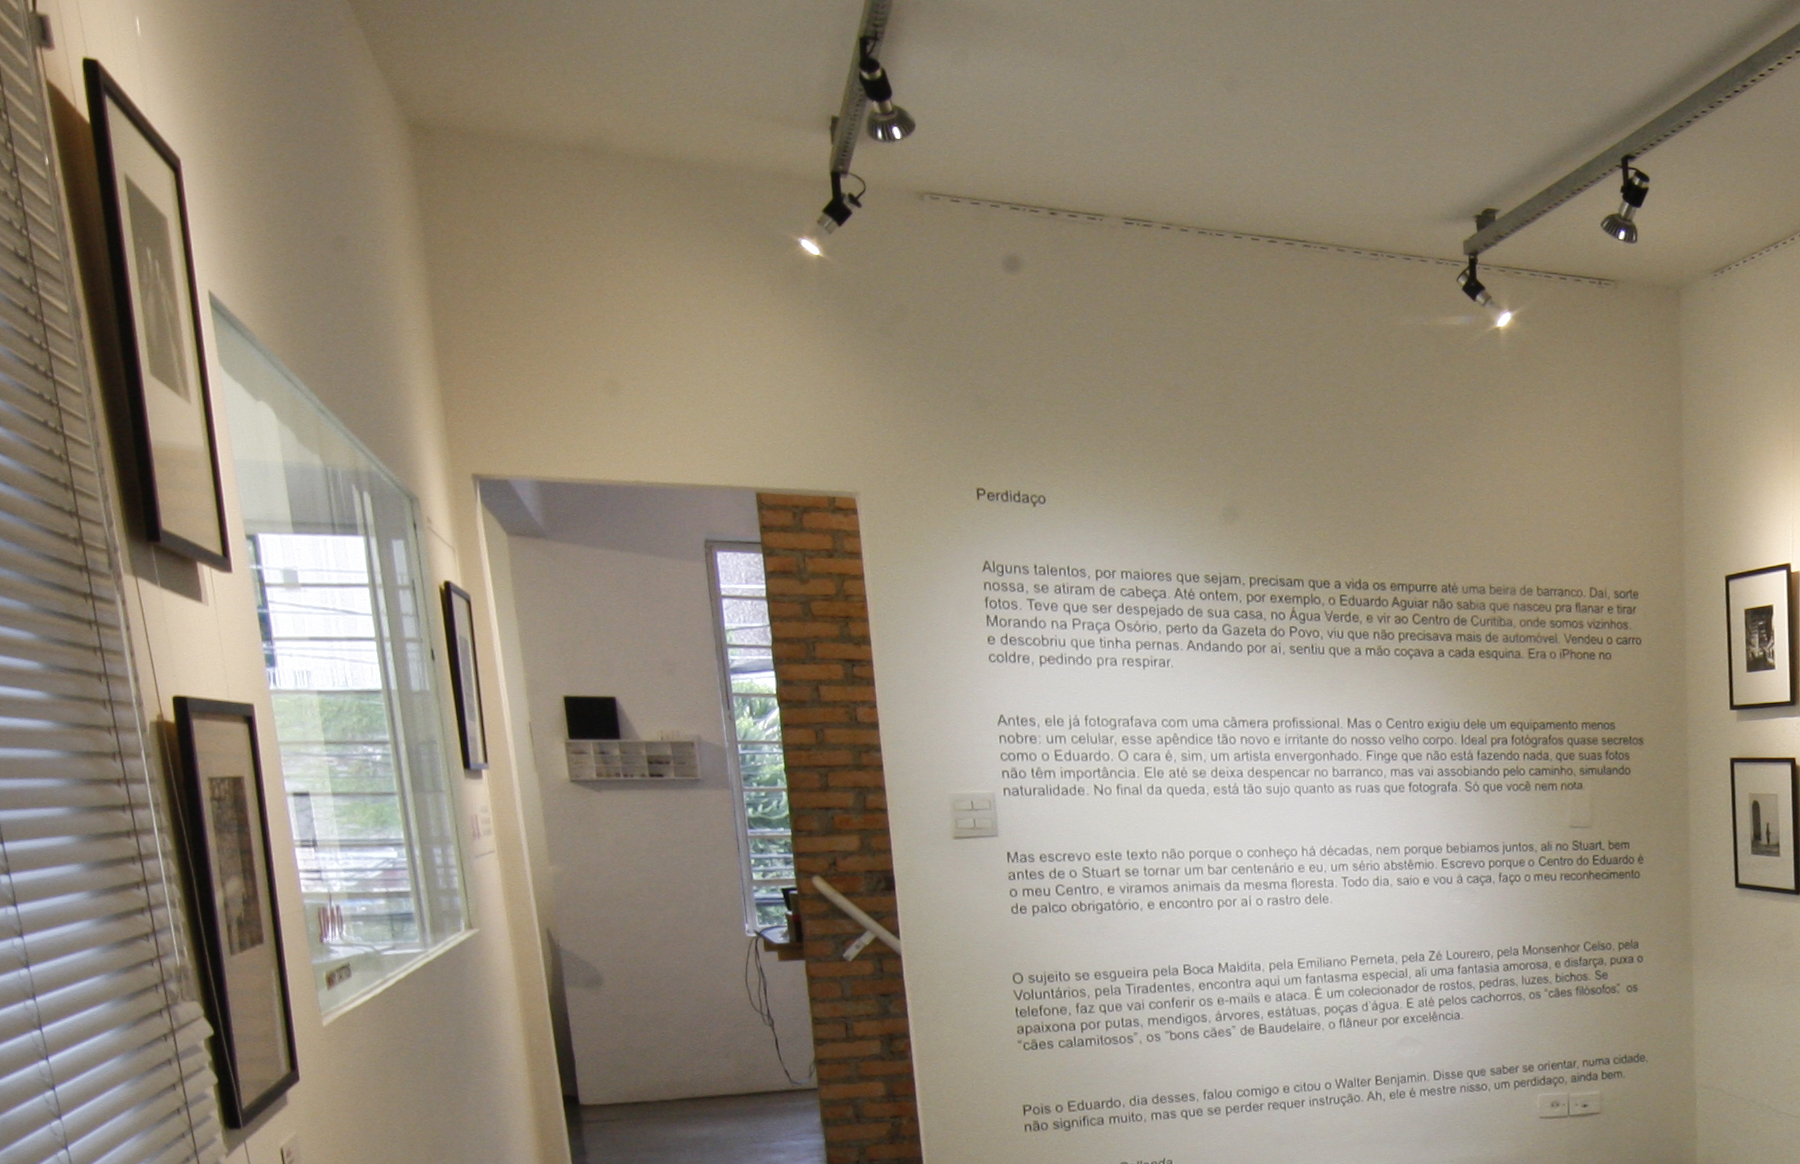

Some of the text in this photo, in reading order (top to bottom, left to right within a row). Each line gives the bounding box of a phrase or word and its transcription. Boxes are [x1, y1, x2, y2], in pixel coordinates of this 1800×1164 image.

[976, 488, 1046, 507] Perdidaço
[981, 561, 1029, 576] Alguns
[1120, 569, 1172, 581] maiores
[1248, 575, 1304, 588] precisam
[1389, 582, 1438, 594] empurre
[1053, 583, 1095, 595] atiram
[1339, 594, 1389, 607] Eduardo
[1391, 596, 1429, 610] Aguiar
[1456, 599, 1486, 610] sabia
[1116, 602, 1184, 618] despejado
[1411, 613, 1450, 625] Centro
[985, 614, 1047, 628] Morando
[1071, 618, 1110, 633] Praça
[1165, 623, 1198, 636] perto
[1221, 624, 1266, 636] Gazeta
[1397, 630, 1452, 643] precisava
[1615, 636, 1642, 645] carro
[999, 633, 1066, 646] descobriu
[1099, 637, 1131, 649] tinha
[1186, 640, 1243, 652] Andando
[1289, 643, 1325, 654] sentiu
[1393, 648, 1434, 659] coçava
[1038, 652, 1092, 667] pedindo
[1084, 715, 1157, 729] fotografava
[1222, 716, 1269, 728] câmera
[1385, 718, 1424, 729] Centro
[1427, 718, 1460, 732] exigiu
[1509, 718, 1578, 732] equipamento
[1156, 733, 1213, 747] apêndice
[1284, 734, 1329, 744] irritante
[1350, 736, 1385, 745] nosso
[1388, 734, 1419, 745] velho
[1460, 734, 1487, 745] Ideal
[1600, 735, 1644, 745] secretos
[1233, 750, 1270, 761] artista
[1365, 750, 1398, 763] Finge
[1476, 749, 1520, 760] fazendo
[1210, 767, 1243, 778] deixa
[1247, 766, 1310, 780] despencar
[1436, 765, 1500, 776] assobiando
[1578, 764, 1631, 775] simulando
[1116, 784, 1143, 795] final
[1293, 783, 1335, 796] quanto
[1038, 852, 1091, 862] escrevo
[1125, 849, 1157, 860] texto
[1188, 850, 1232, 861] porque
[1246, 846, 1298, 859] conheço
[1403, 845, 1443, 857] porque
[1007, 869, 1045, 880] antes
[1081, 867, 1121, 878] Stuart
[1143, 866, 1180, 876] tornar
[1231, 862, 1294, 874] centenário
[1352, 860, 1380, 871] sério
[1440, 858, 1485, 869] Escrevo
[1591, 854, 1635, 865] Eduardo
[1119, 883, 1169, 894] viramos
[1172, 880, 1221, 892] animais
[1243, 881, 1288, 890] mesma
[1559, 868, 1641, 881] reconhecimento
[1031, 901, 1067, 916] palco
[1158, 897, 1213, 909] encontro
[1266, 894, 1301, 906] rastro
[1027, 971, 1071, 985] sujeito
[1093, 967, 1149, 981] esgueira
[1297, 957, 1347, 969] Emiliano
[1521, 942, 1580, 955] Monsenhor
[1198, 978, 1251, 990] encontra
[1305, 973, 1358, 984] fantasma
[1457, 962, 1500, 974] fantasia
[1148, 996, 1195, 1009] conferir
[1216, 992, 1260, 1005] e-mails
[1347, 982, 1419, 997] colecionador
[1016, 1021, 1076, 1035] apaixona
[1323, 1004, 1358, 1017] poças
[1438, 994, 1467, 1009] pelos
[1338, 1017, 1378, 1029] flâneur
[1202, 1088, 1232, 1100] falou
[1236, 1085, 1279, 1097] comigo
[1293, 1081, 1321, 1092] citou
[1334, 1077, 1371, 1089] Walter
[1432, 1069, 1463, 1080] Disse
[1052, 1115, 1105, 1131] significa
[1225, 1101, 1264, 1116] perder
[1267, 1099, 1305, 1111] requer
[1419, 1085, 1457, 1096] mestre
